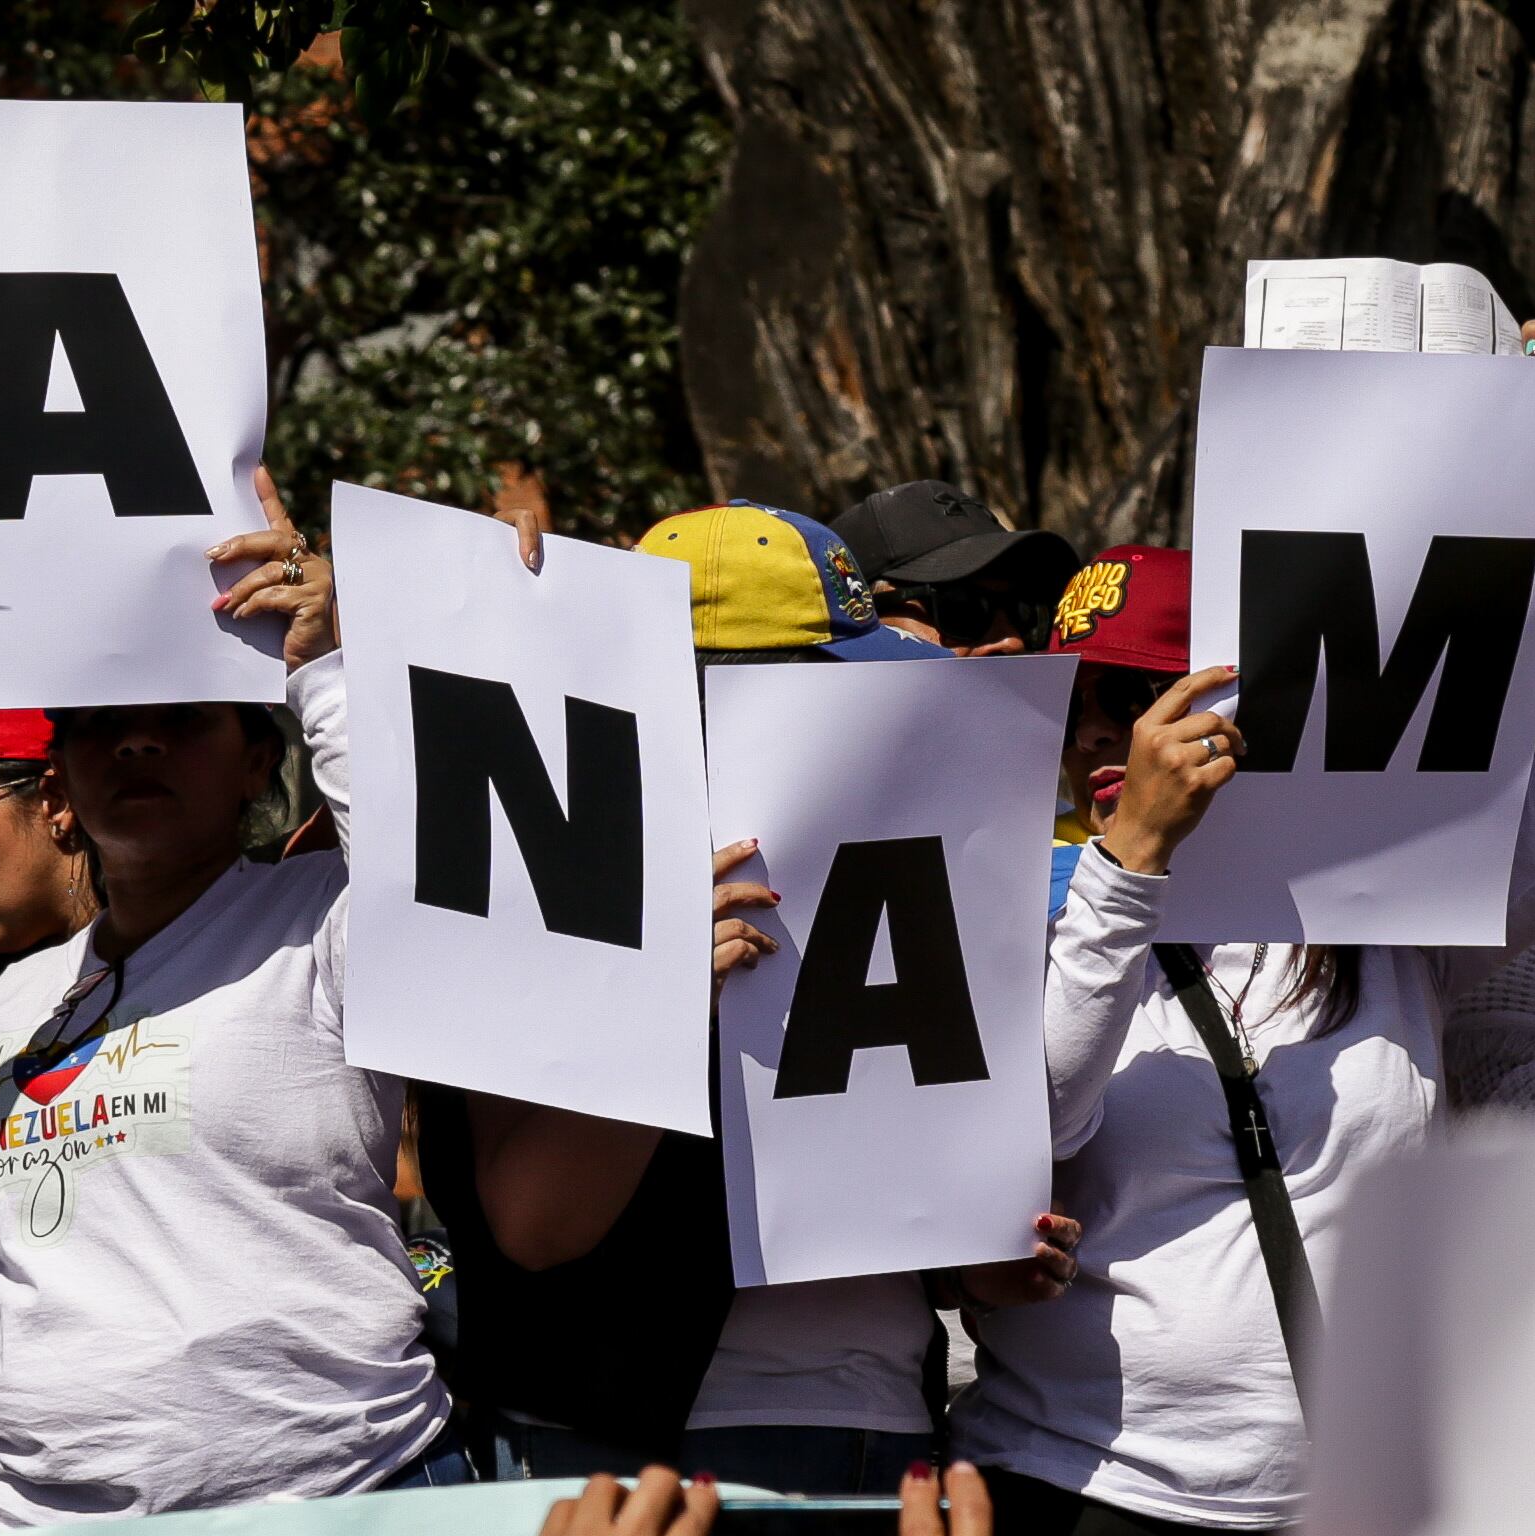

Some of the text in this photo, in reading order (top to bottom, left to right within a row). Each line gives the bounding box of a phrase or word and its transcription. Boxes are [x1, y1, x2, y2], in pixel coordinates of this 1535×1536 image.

[409, 661, 647, 950] N
[776, 836, 991, 1097] A
[112, 1094, 136, 1118] EN
[144, 1092, 167, 1114] MI
